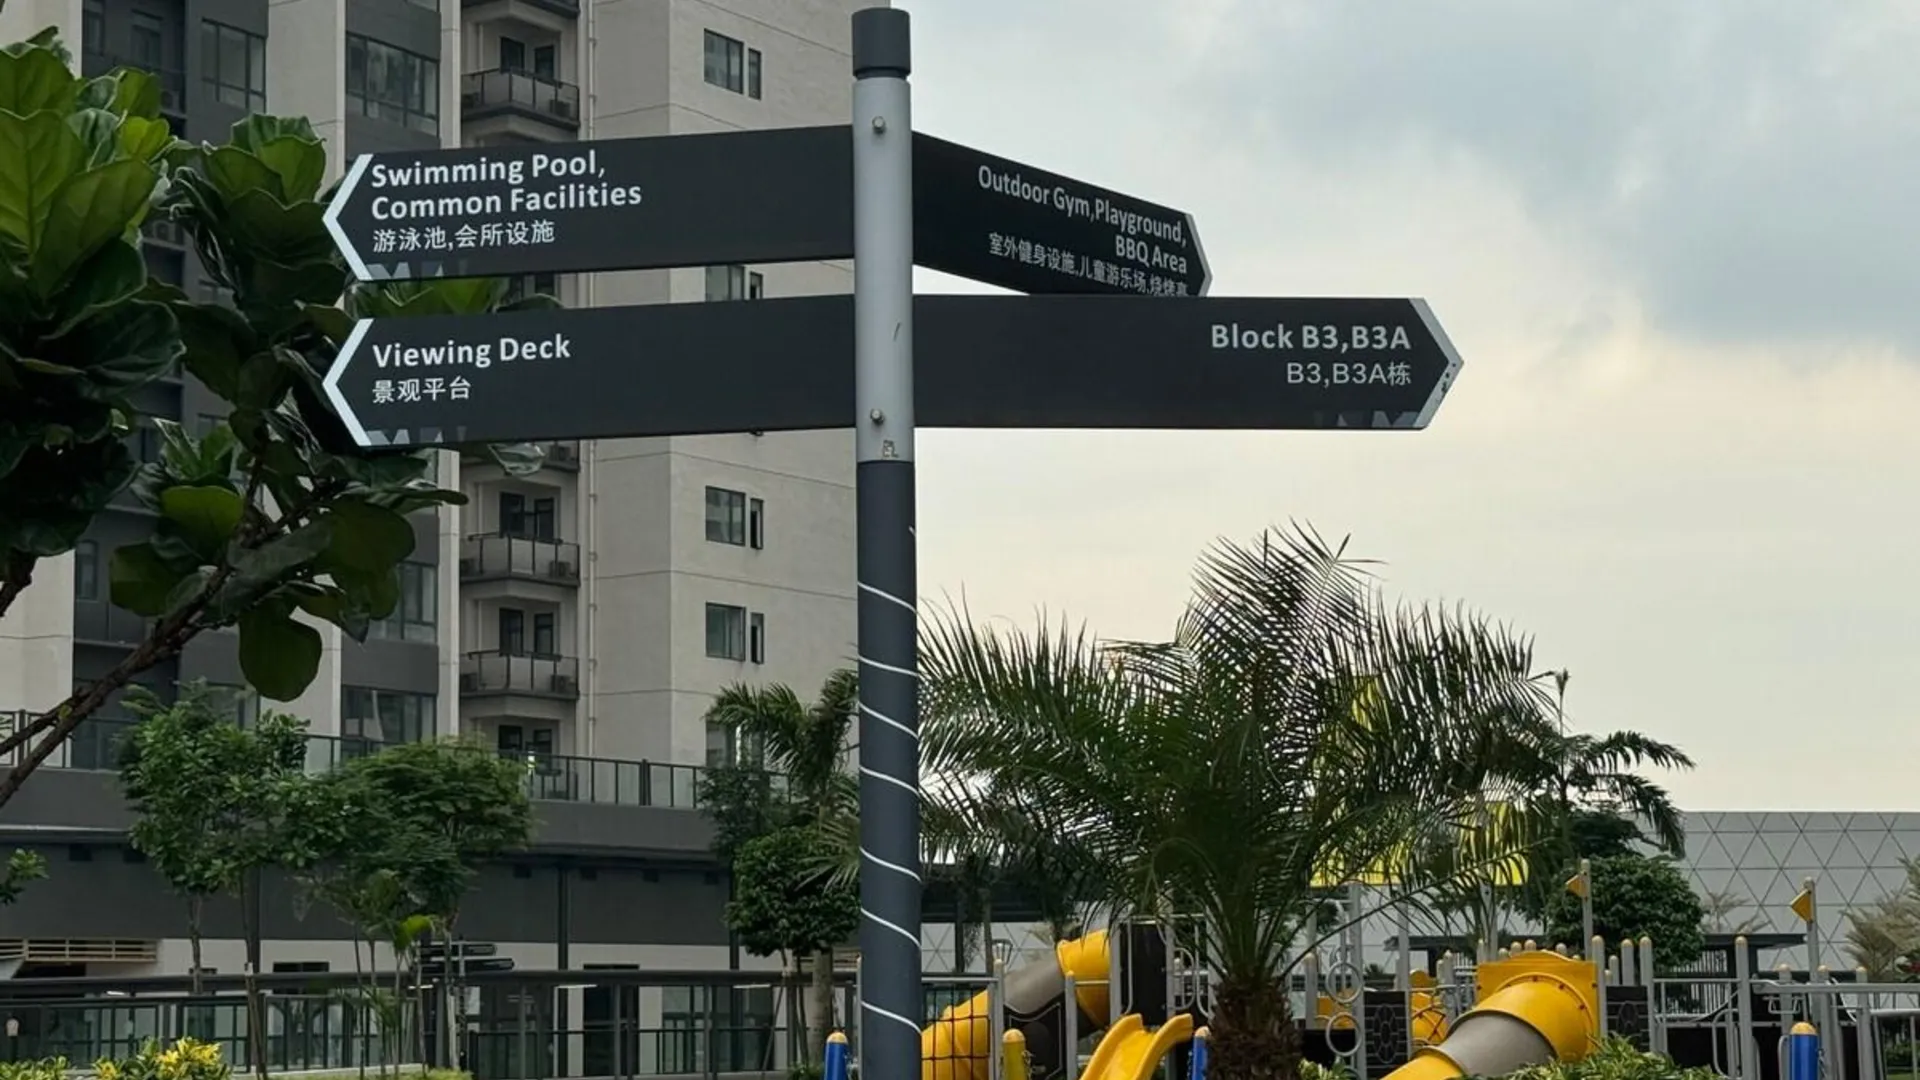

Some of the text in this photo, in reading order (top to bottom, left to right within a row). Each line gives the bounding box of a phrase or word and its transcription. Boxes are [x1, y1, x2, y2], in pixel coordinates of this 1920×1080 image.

[372, 149, 606, 187] Swimming Pool,
[978, 165, 1050, 204] Outdoor
[372, 183, 642, 220] Common Facilities
[372, 219, 556, 253] 游泳池,会所设施
[1116, 235, 1187, 274] BBQ Area
[372, 333, 571, 368] Viewing Deck
[1211, 323, 1411, 354] Block B3,B3A
[372, 375, 472, 403] 景观平台
[1287, 361, 1411, 388] B3,B3A栋
